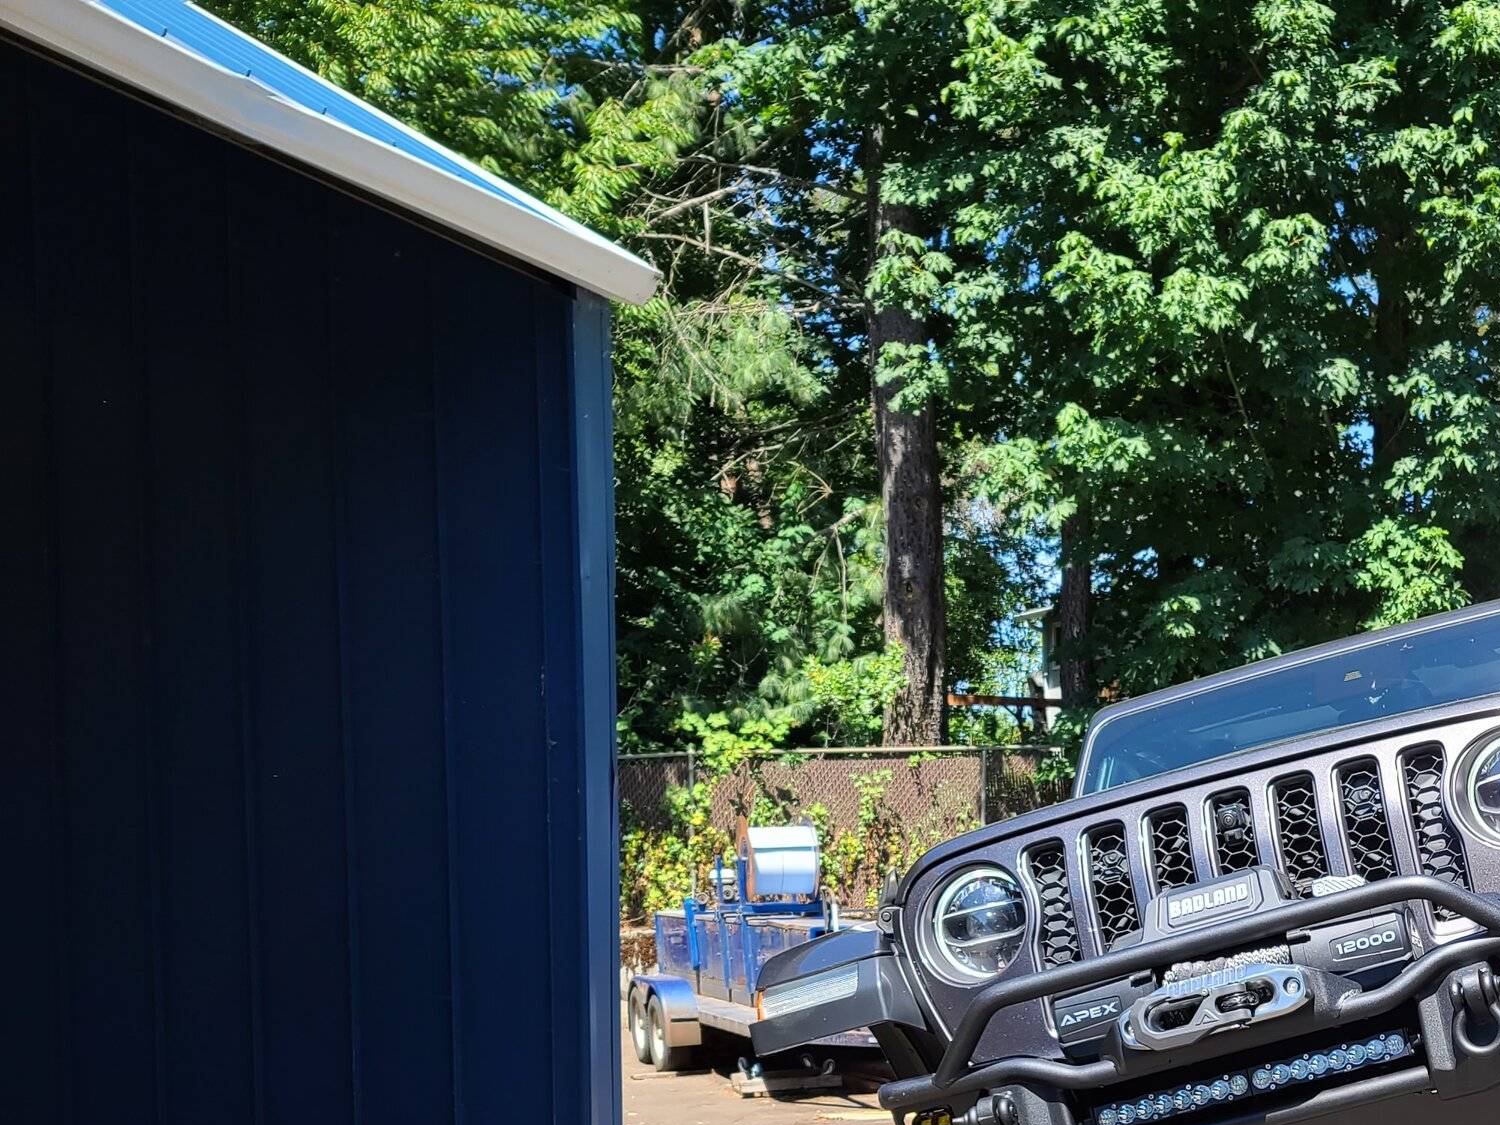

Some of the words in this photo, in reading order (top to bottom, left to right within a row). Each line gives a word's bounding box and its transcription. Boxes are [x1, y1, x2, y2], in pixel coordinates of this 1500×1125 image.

[1168, 882, 1249, 920] BADLAND
[1335, 930, 1397, 956] 12000
[1060, 1001, 1119, 1027] APEX
